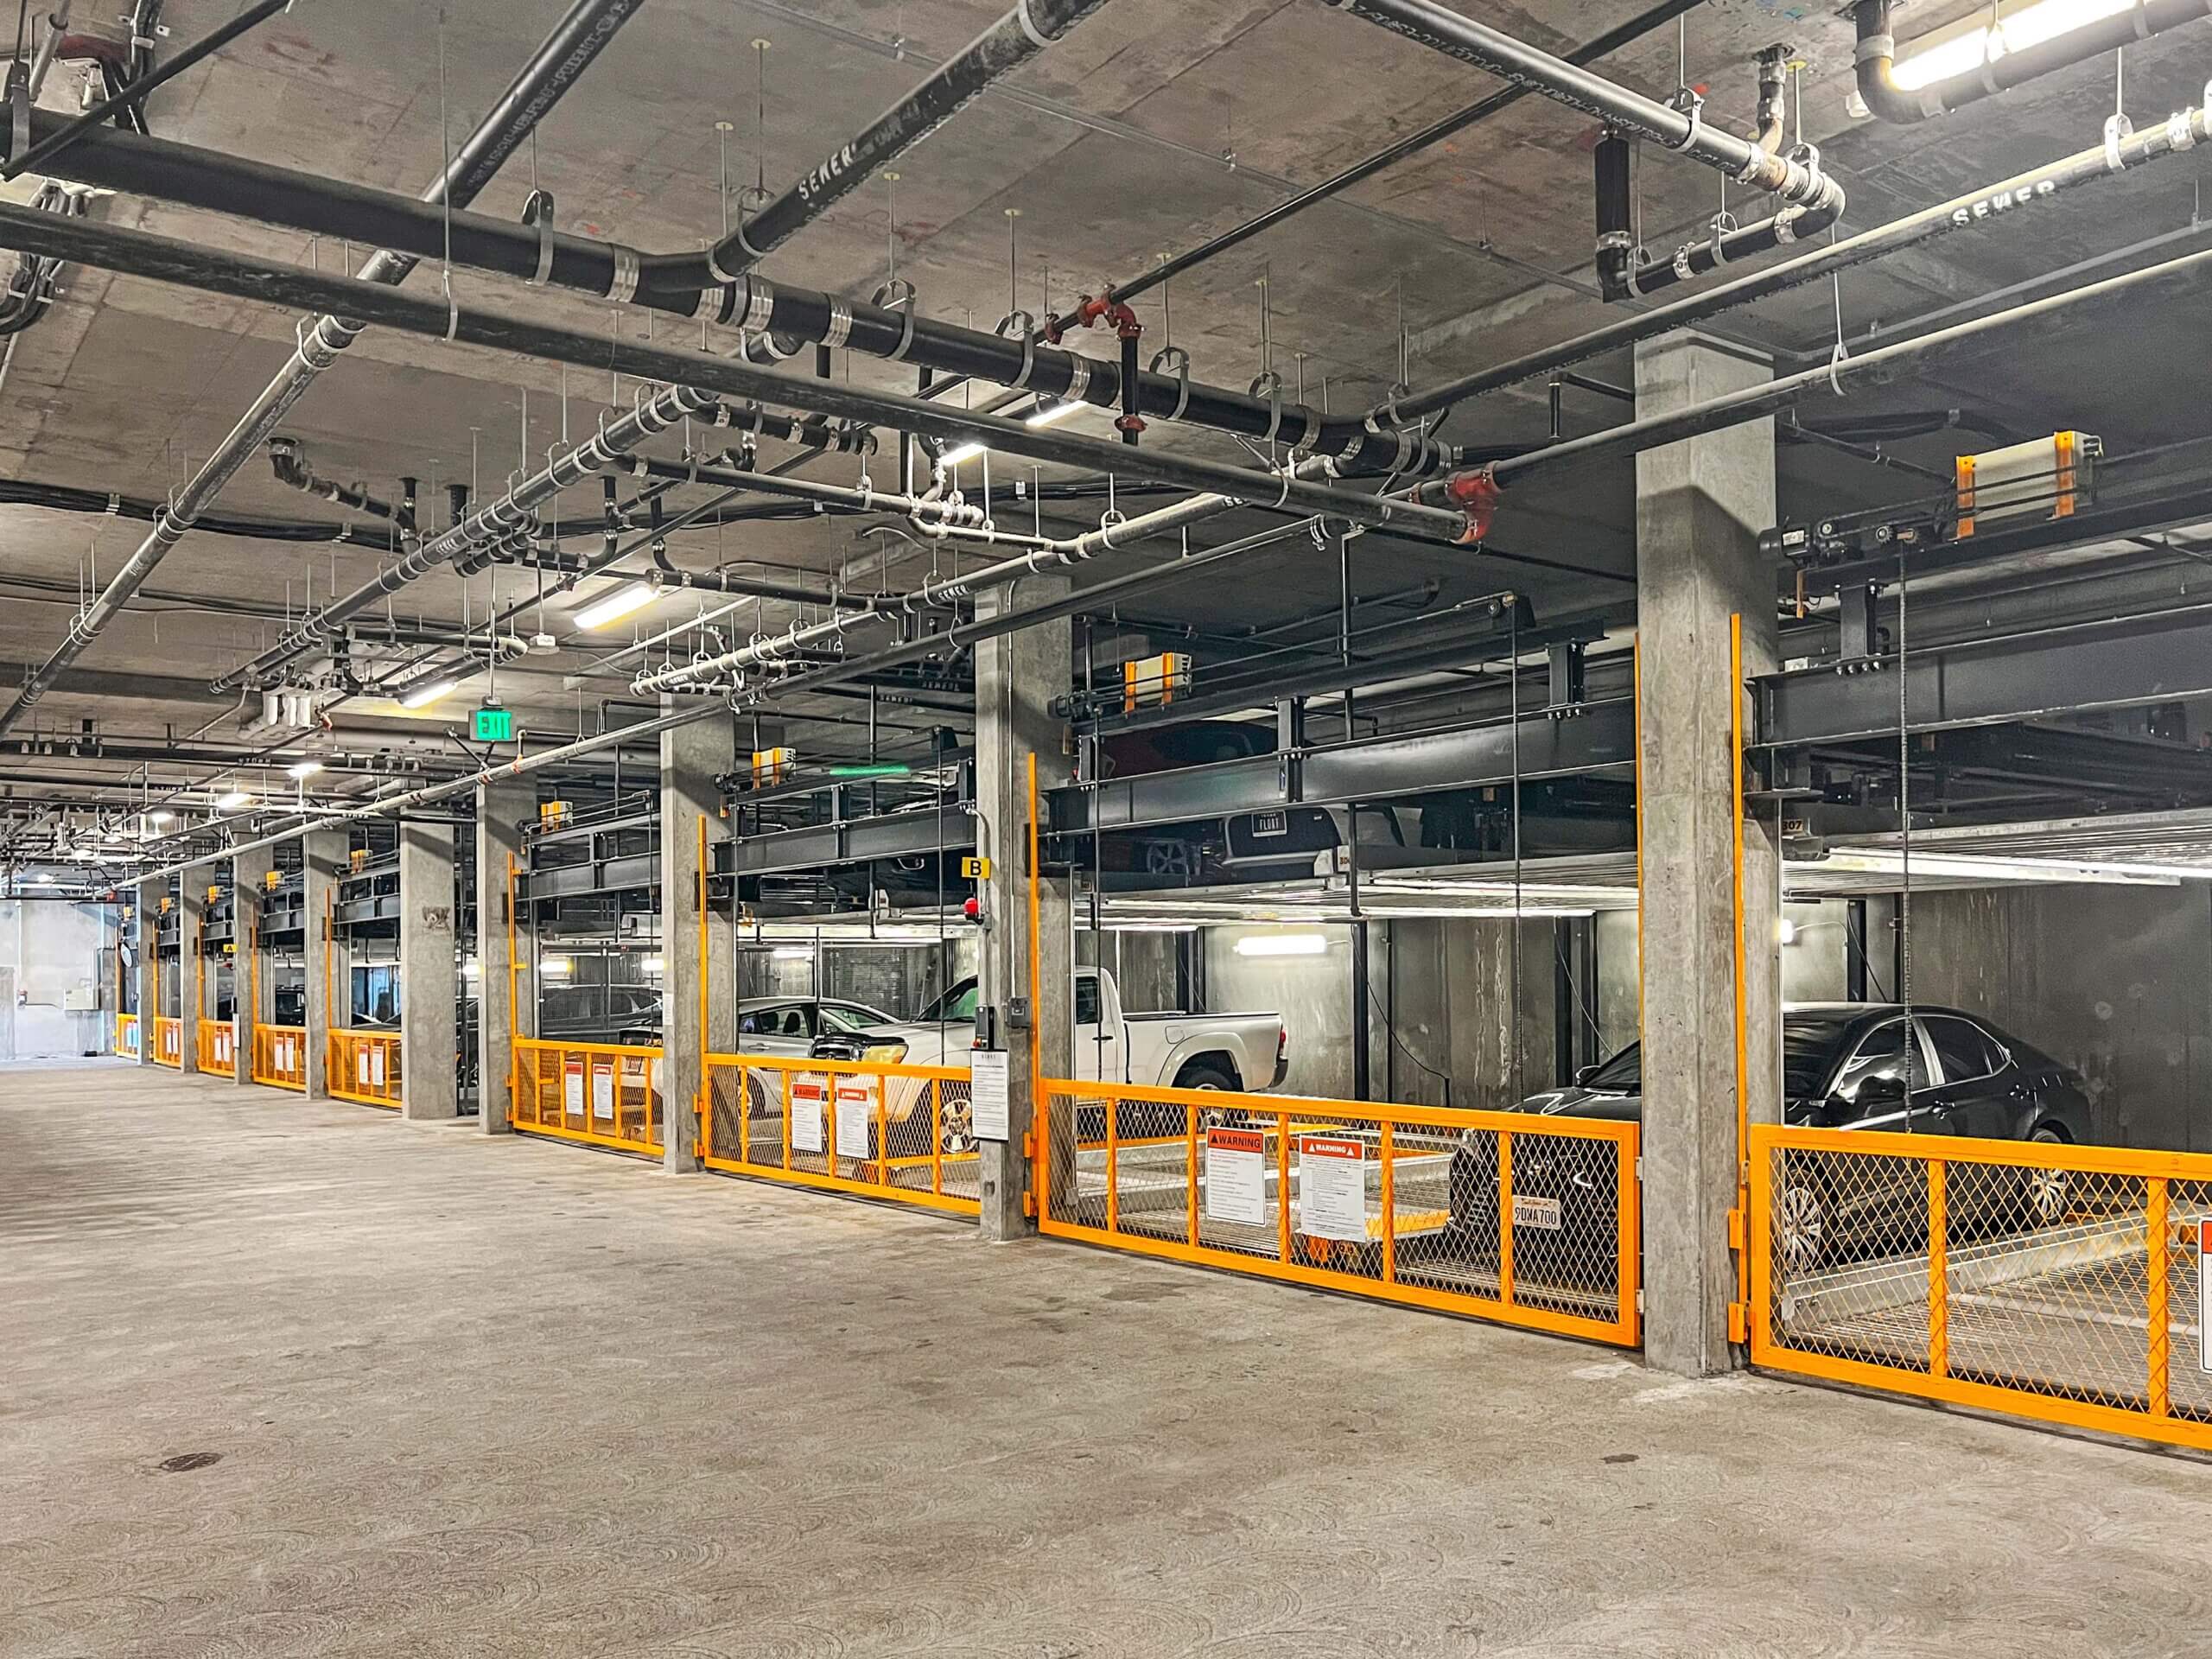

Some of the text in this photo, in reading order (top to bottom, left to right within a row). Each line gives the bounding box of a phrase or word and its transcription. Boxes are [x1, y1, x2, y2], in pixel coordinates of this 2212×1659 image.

[798, 144, 853, 200] SEWER
[1952, 180, 2056, 226] SEWER
[476, 711, 512, 740] EXIT
[970, 861, 982, 875] B
[1219, 1135, 1260, 1148] WARNING
[1315, 1143, 1346, 1154] WARNING
